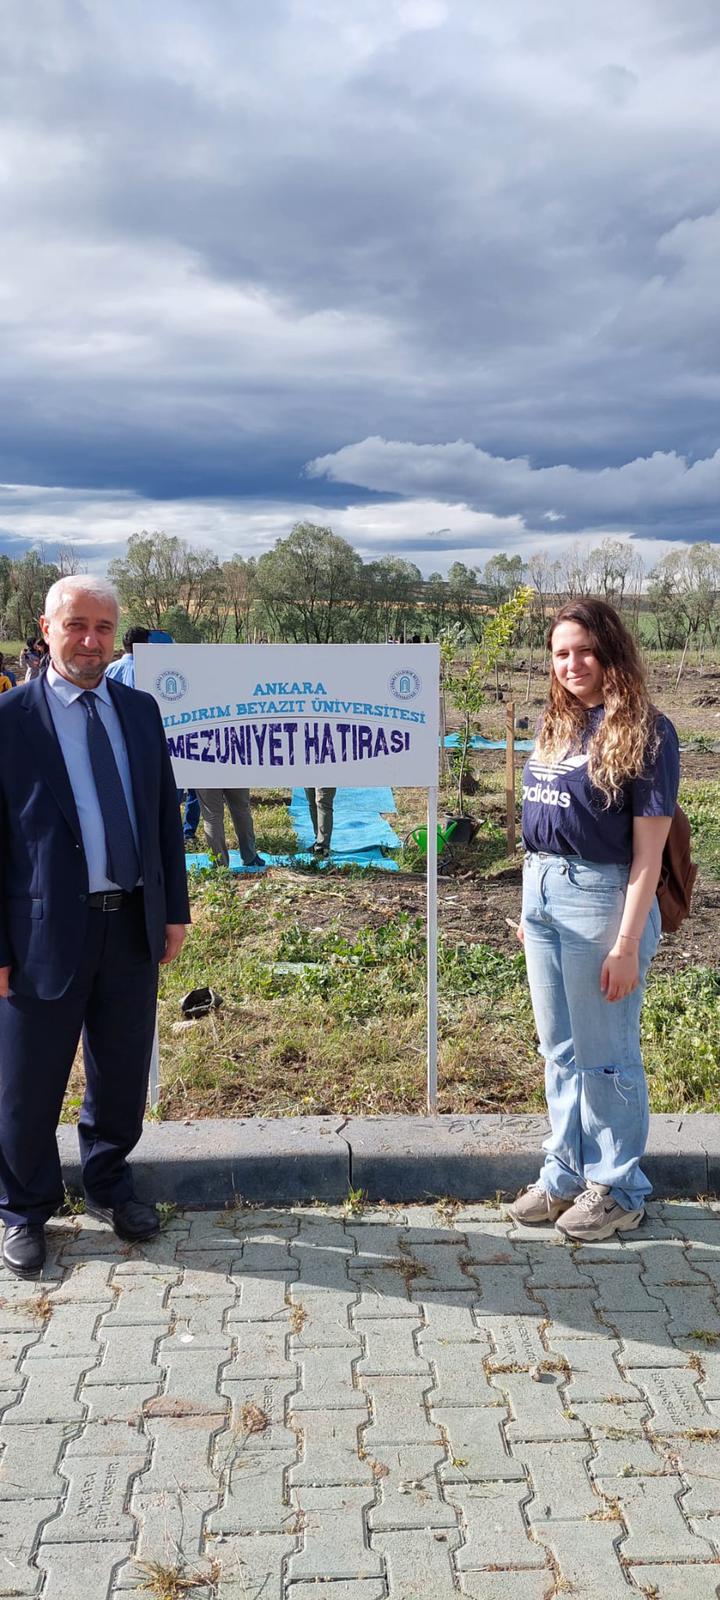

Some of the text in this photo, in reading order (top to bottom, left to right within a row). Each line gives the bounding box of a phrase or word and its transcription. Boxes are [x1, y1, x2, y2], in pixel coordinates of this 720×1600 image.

[252, 681, 327, 696] ANKARA
[163, 697, 426, 728] ILDIRIM BEYAZIT ÜNİVERSİTESİ
[167, 722, 410, 766] MEZUNIYET HATIRASI
